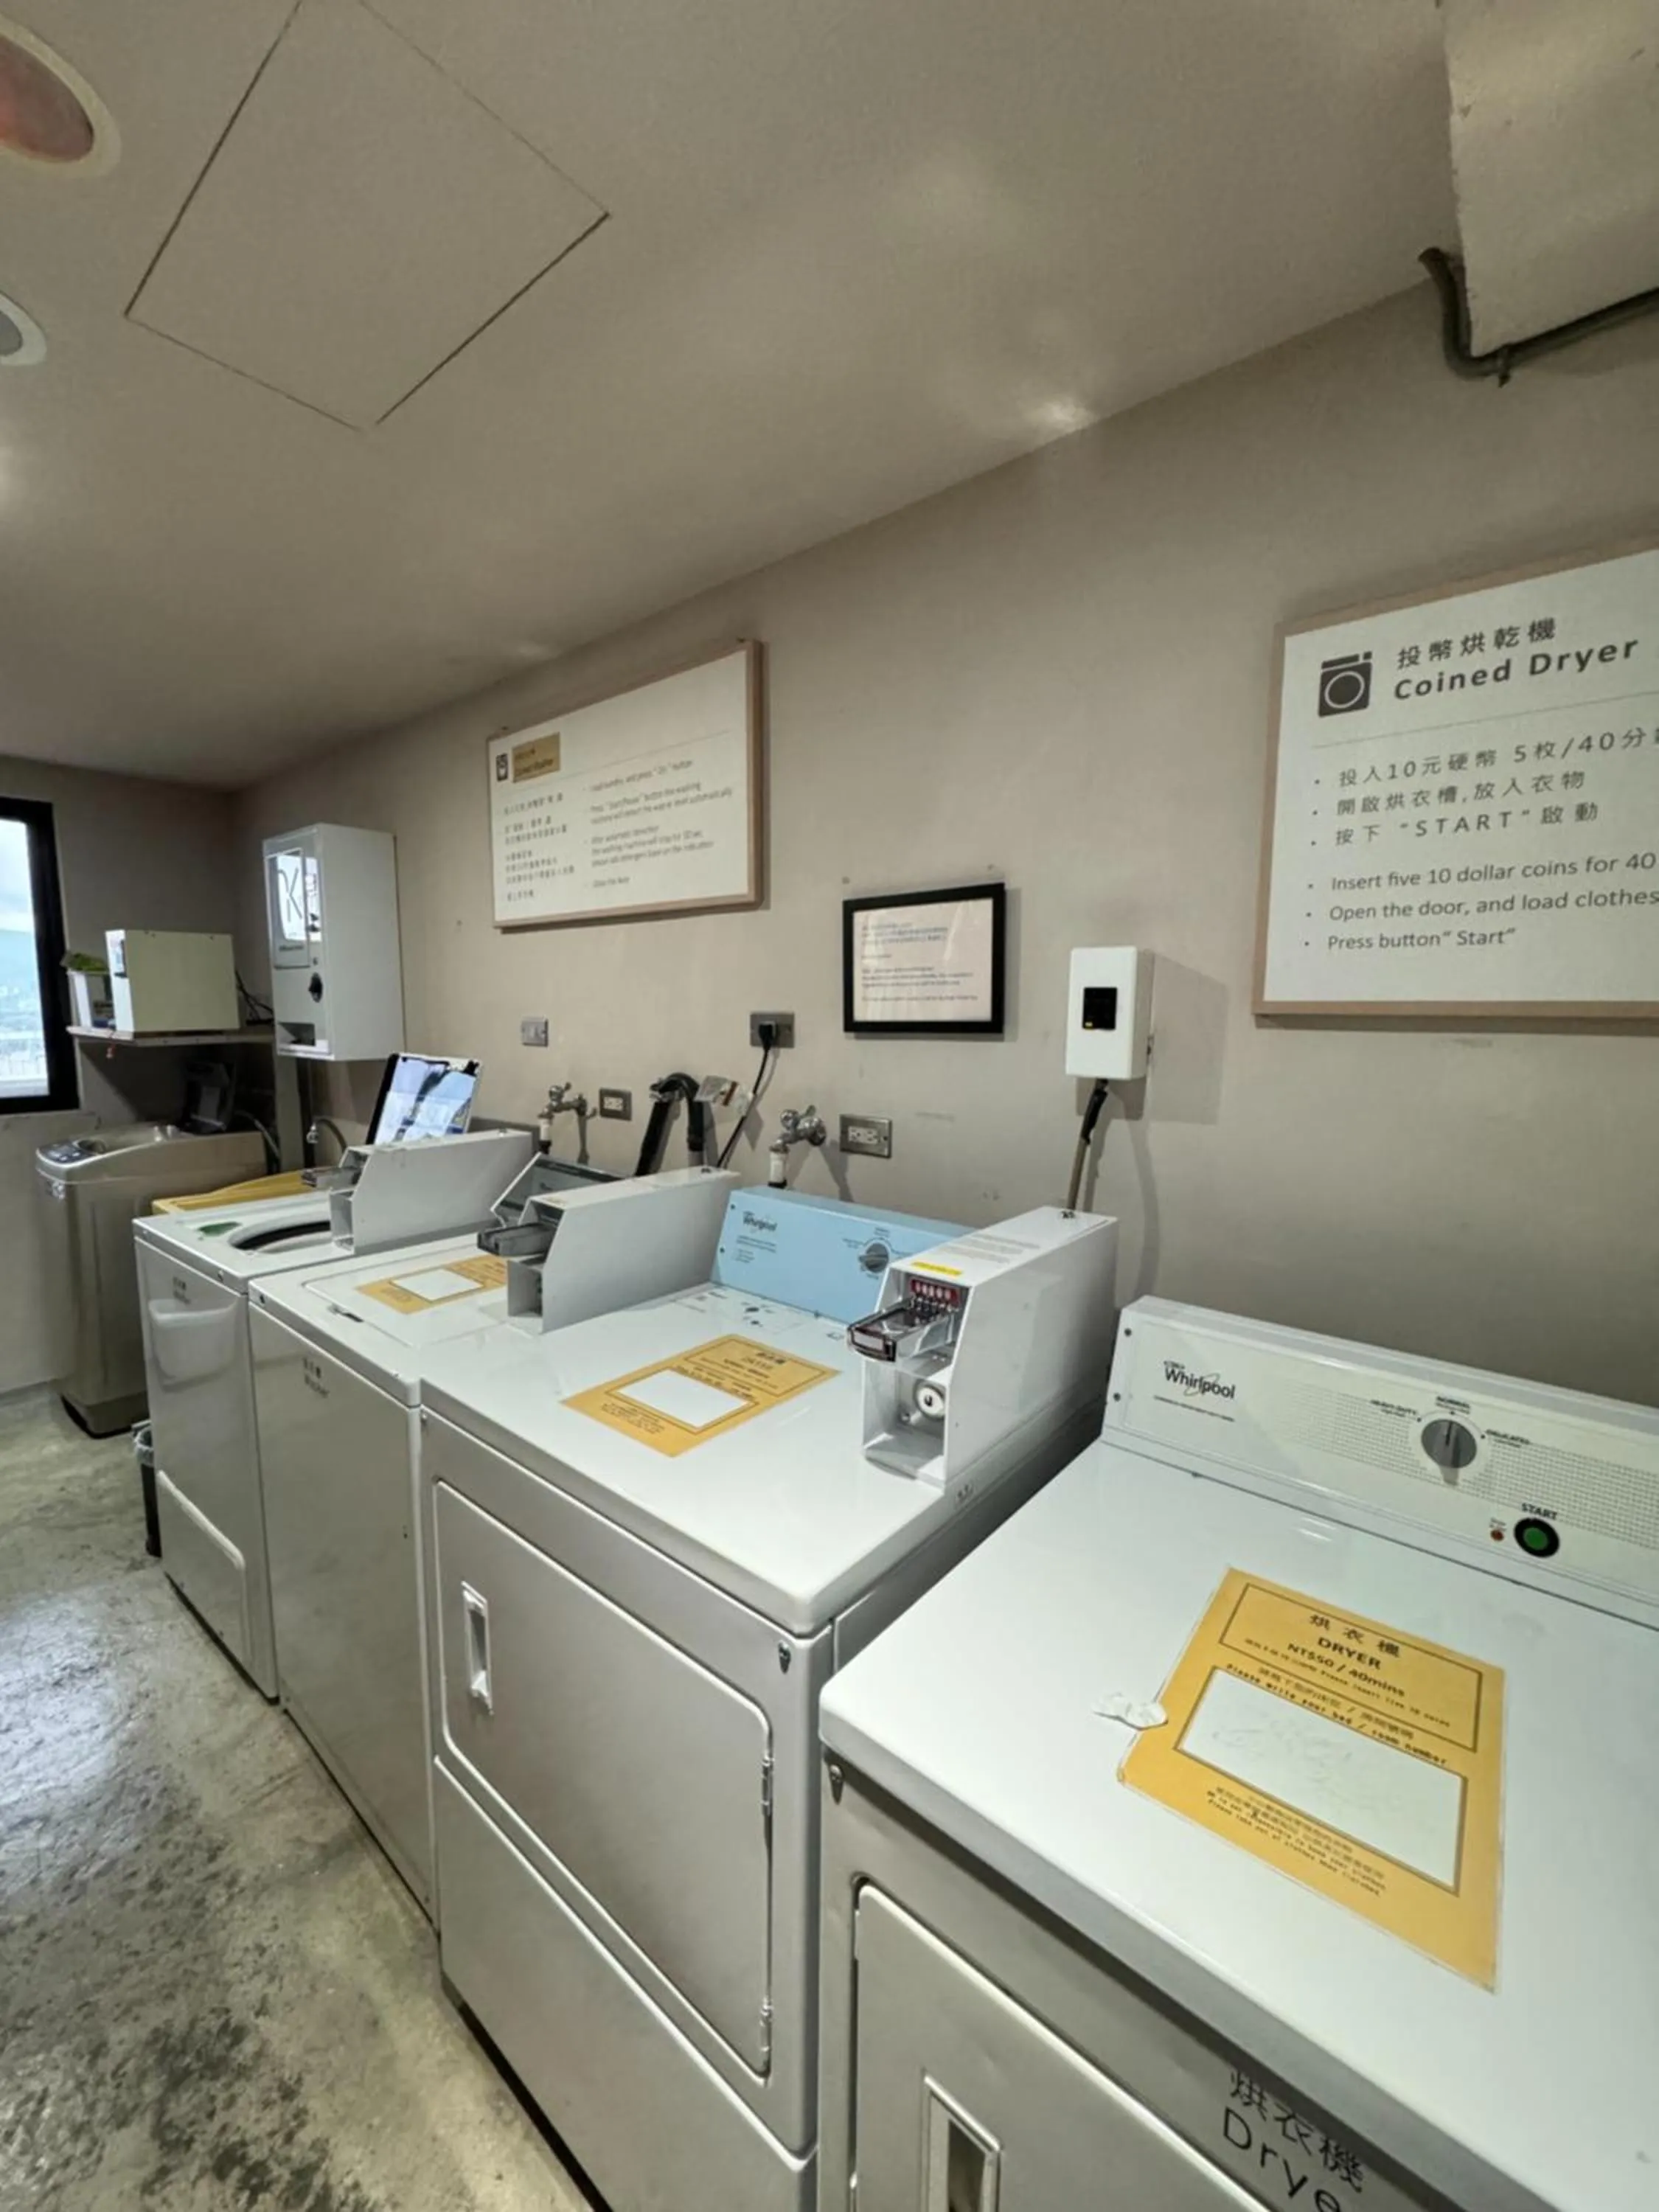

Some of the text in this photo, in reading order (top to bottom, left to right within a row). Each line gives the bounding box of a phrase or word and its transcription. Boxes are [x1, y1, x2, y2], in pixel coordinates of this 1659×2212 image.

[1397, 618, 1556, 669] 投幣烘乾機
[1394, 639, 1638, 700] Coined Dryer
[1331, 852, 1657, 891] Insert five 10 dollar coins for 40
[1329, 887, 1659, 922] Open the door, and load clothes
[1327, 934, 1374, 951] Press
[1164, 1364, 1237, 1400] Whirlpool
[1521, 1503, 1558, 1521] START
[1318, 1636, 1382, 1670] DRYER
[1348, 1668, 1405, 1697] 40mins
[1230, 2070, 1363, 2194] 烘衣機
